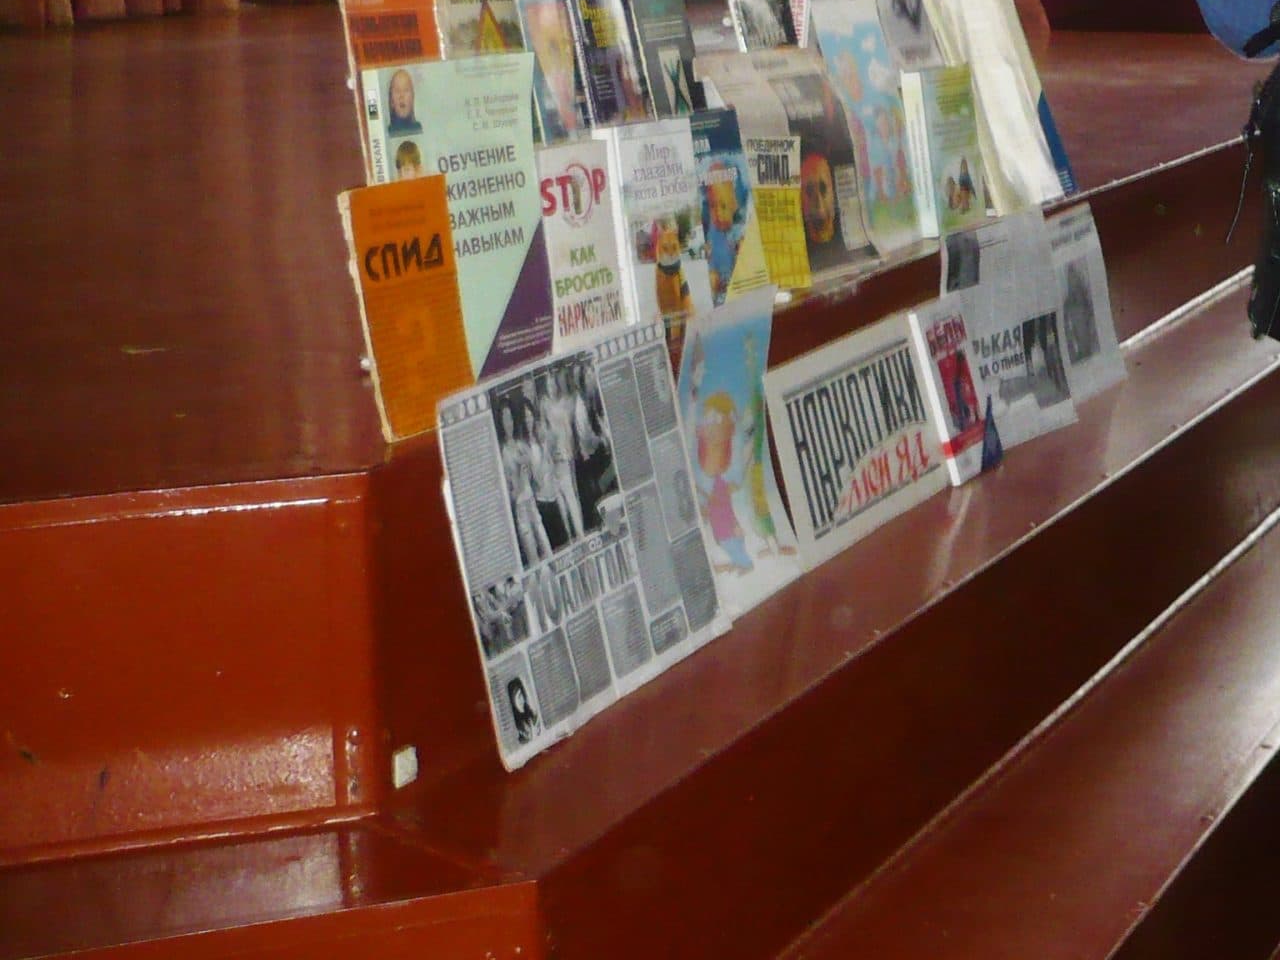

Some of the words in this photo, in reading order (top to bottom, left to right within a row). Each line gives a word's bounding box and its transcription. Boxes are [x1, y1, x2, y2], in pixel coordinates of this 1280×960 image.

[438, 145, 516, 174] ОБУЧЕНИЕ
[645, 143, 670, 161] Мир
[540, 162, 607, 222] STOP
[365, 233, 443, 282] СПИД
[569, 245, 597, 266] КАК
[555, 267, 614, 298] БРОСИТЬ
[786, 346, 927, 530] НАРКОТИКИ
